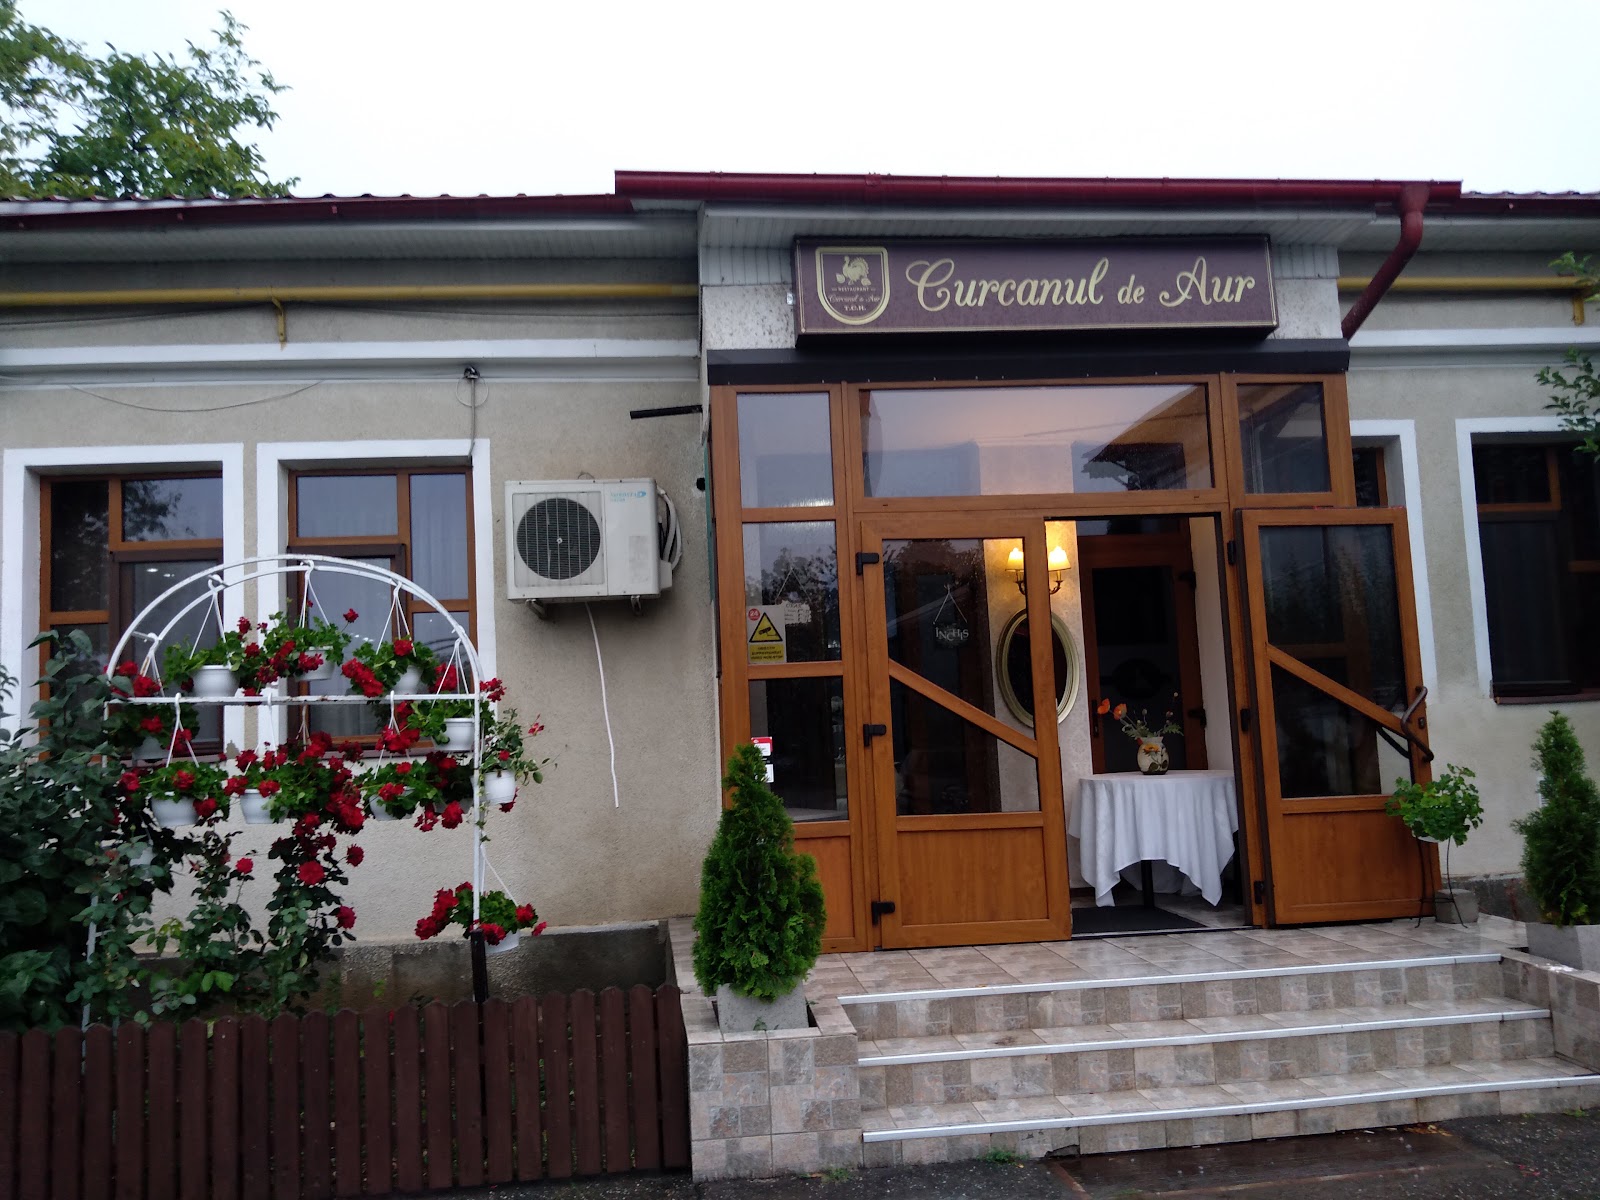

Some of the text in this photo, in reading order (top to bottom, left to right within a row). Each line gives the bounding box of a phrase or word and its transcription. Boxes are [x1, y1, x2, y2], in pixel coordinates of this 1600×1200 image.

[905, 255, 1256, 312] Curcanul de Aur
